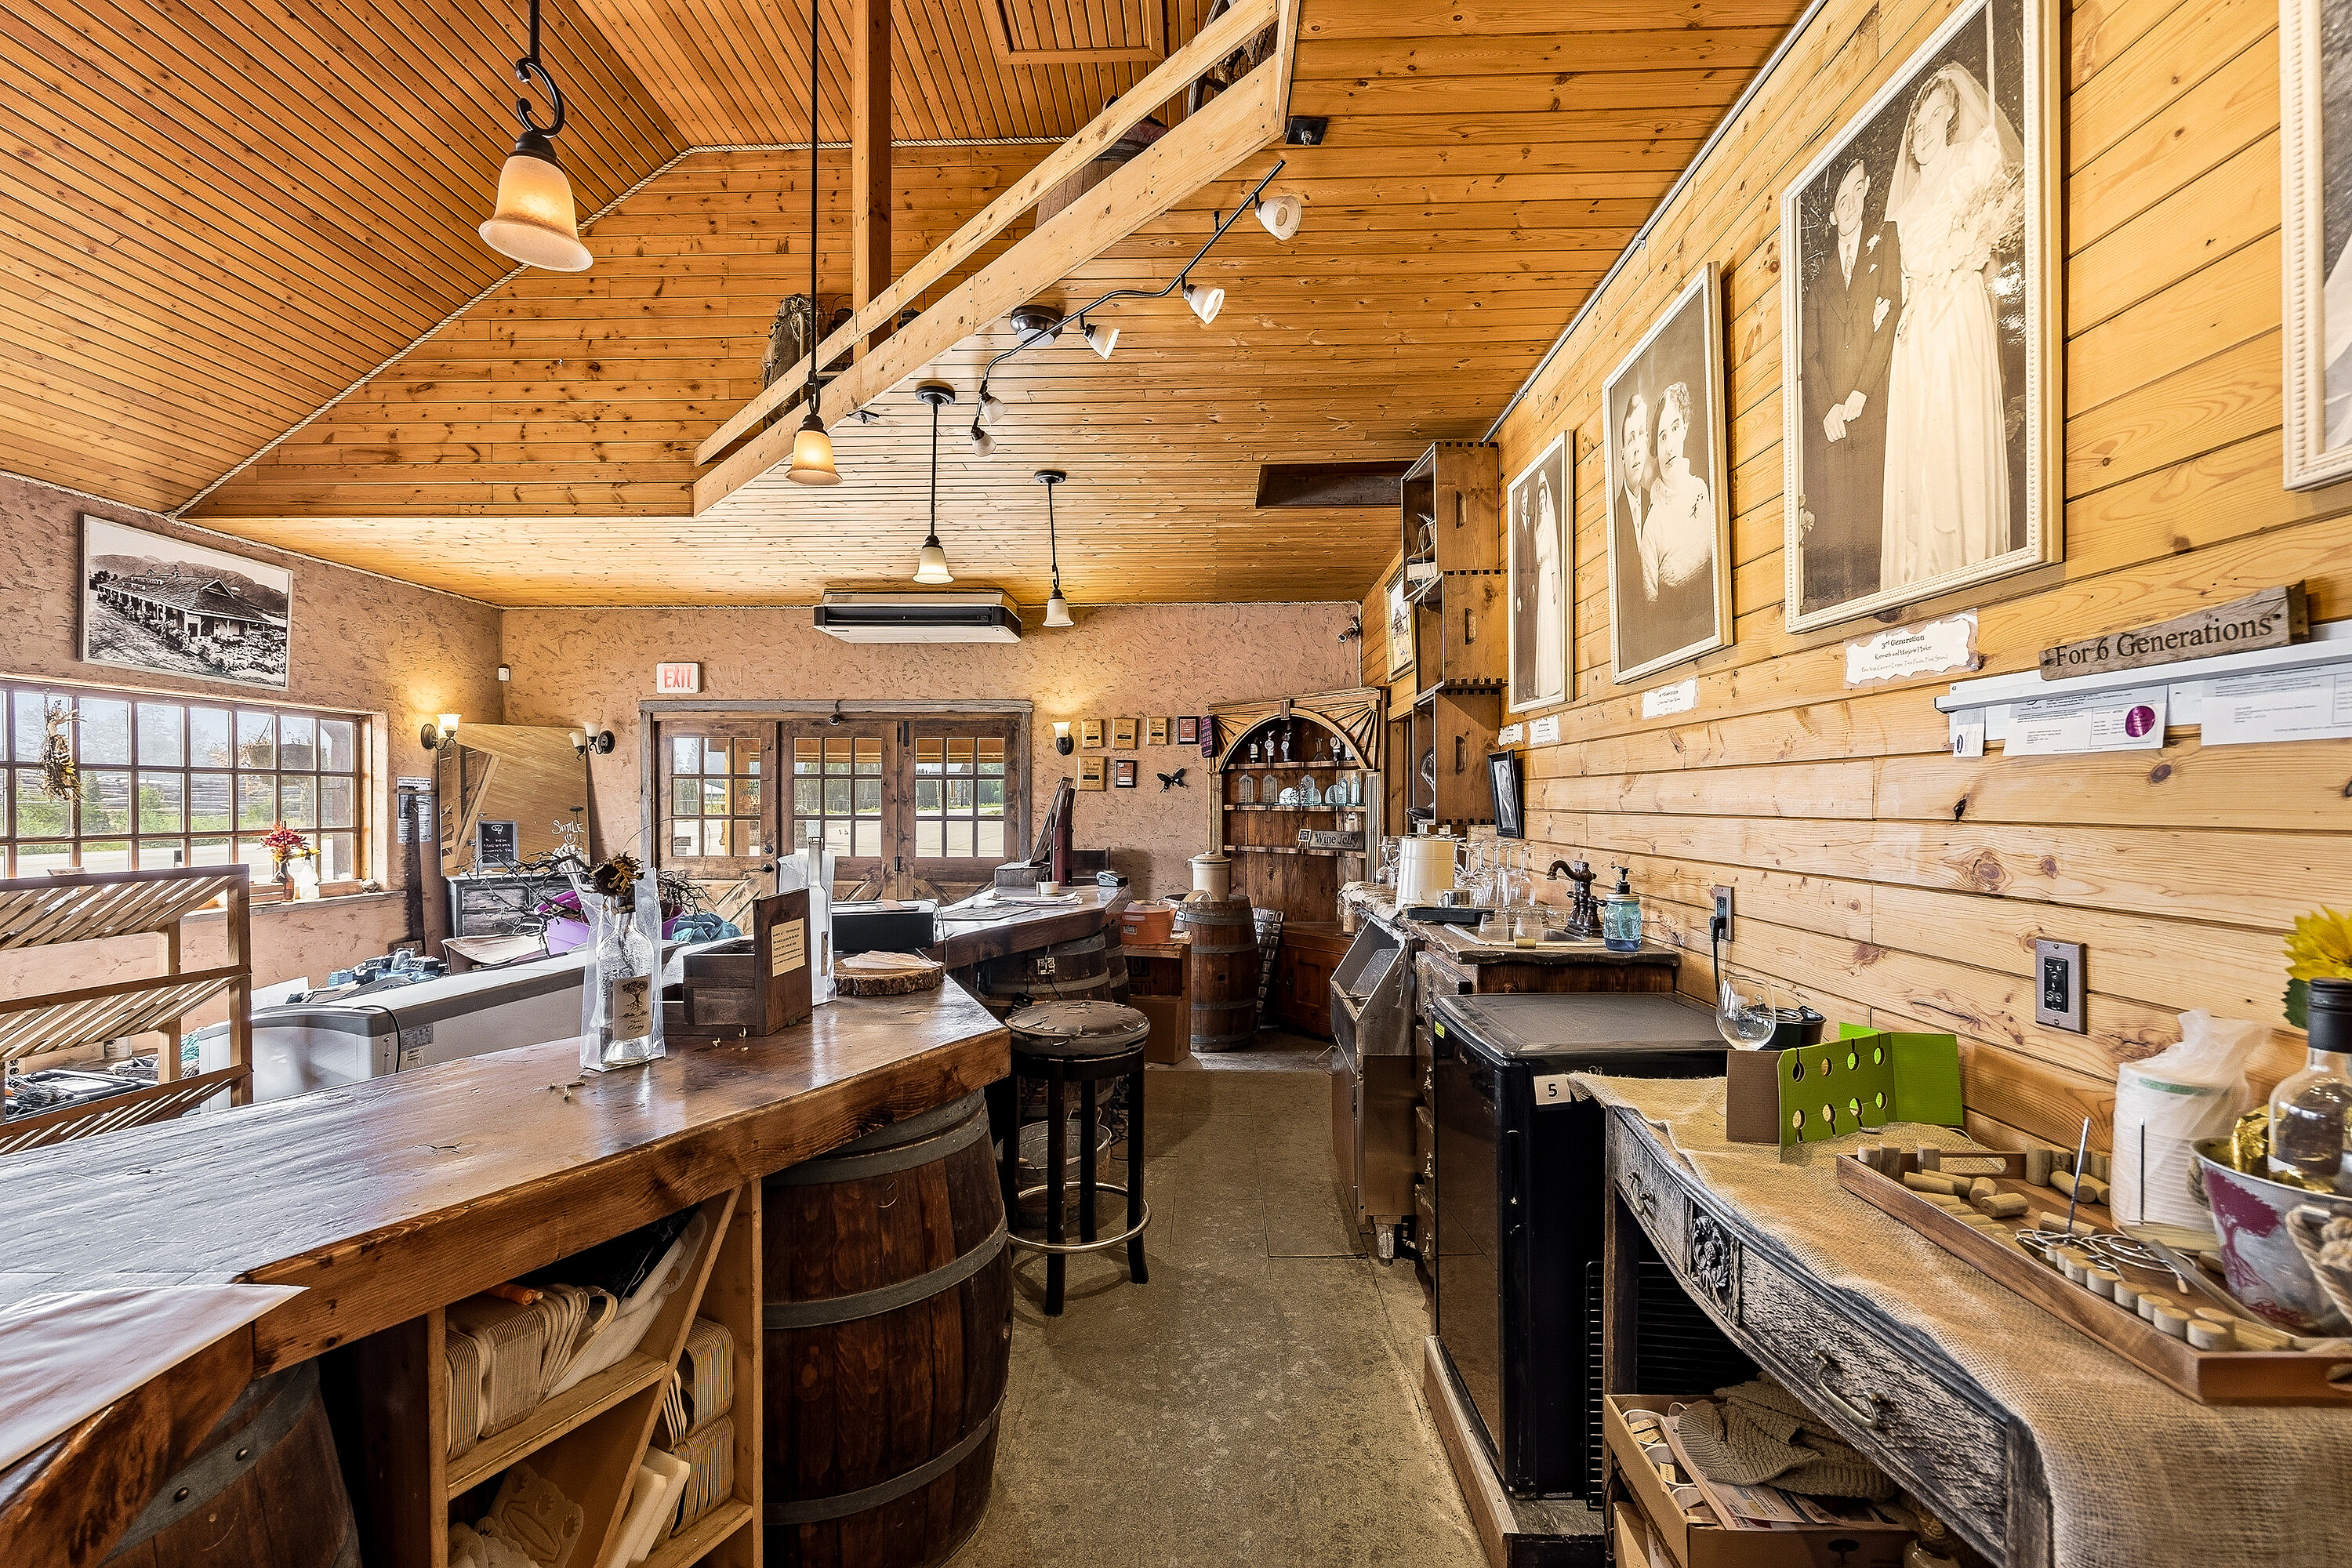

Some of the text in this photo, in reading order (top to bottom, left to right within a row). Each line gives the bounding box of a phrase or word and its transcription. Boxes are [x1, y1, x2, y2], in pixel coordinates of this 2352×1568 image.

[1890, 634, 1926, 647] Generation
[2054, 615, 2273, 666] For 6 Generations
[663, 665, 691, 688] EXIT
[1315, 833, 1336, 844] Wine
[1548, 1083, 1558, 1098] 5
